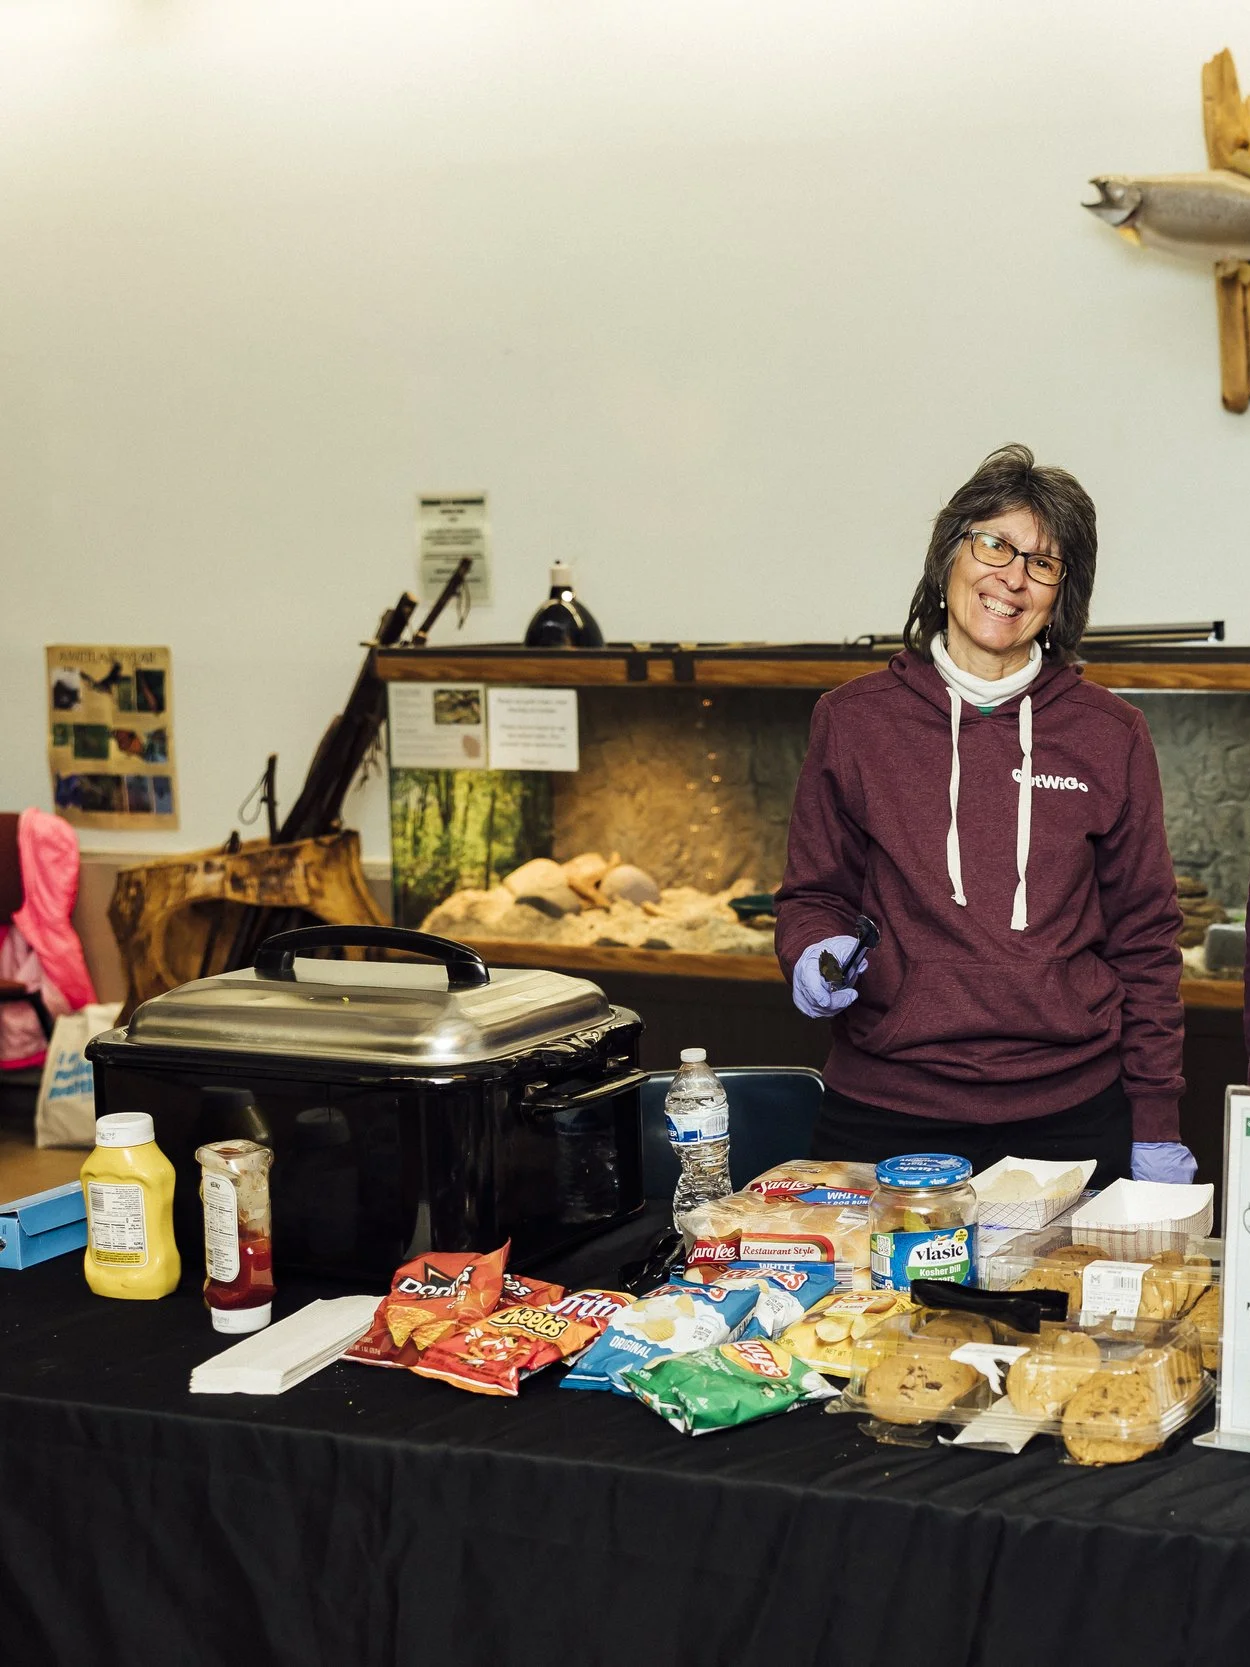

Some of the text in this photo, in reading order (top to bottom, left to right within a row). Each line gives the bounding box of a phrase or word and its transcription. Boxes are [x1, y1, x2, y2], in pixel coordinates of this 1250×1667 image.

[1010, 768, 1089, 793] OtWiGo
[754, 1181, 790, 1195] Sara
[714, 1243, 739, 1260] Lee
[743, 1245, 815, 1256] Restaurant Style
[916, 1244, 964, 1261] vlasic
[759, 1262, 795, 1271] WHITE
[919, 1264, 961, 1277] Kosher Dill
[547, 1291, 623, 1322] Frito
[489, 1306, 569, 1339] Cheetos
[609, 1334, 652, 1360] ORIGINAL
